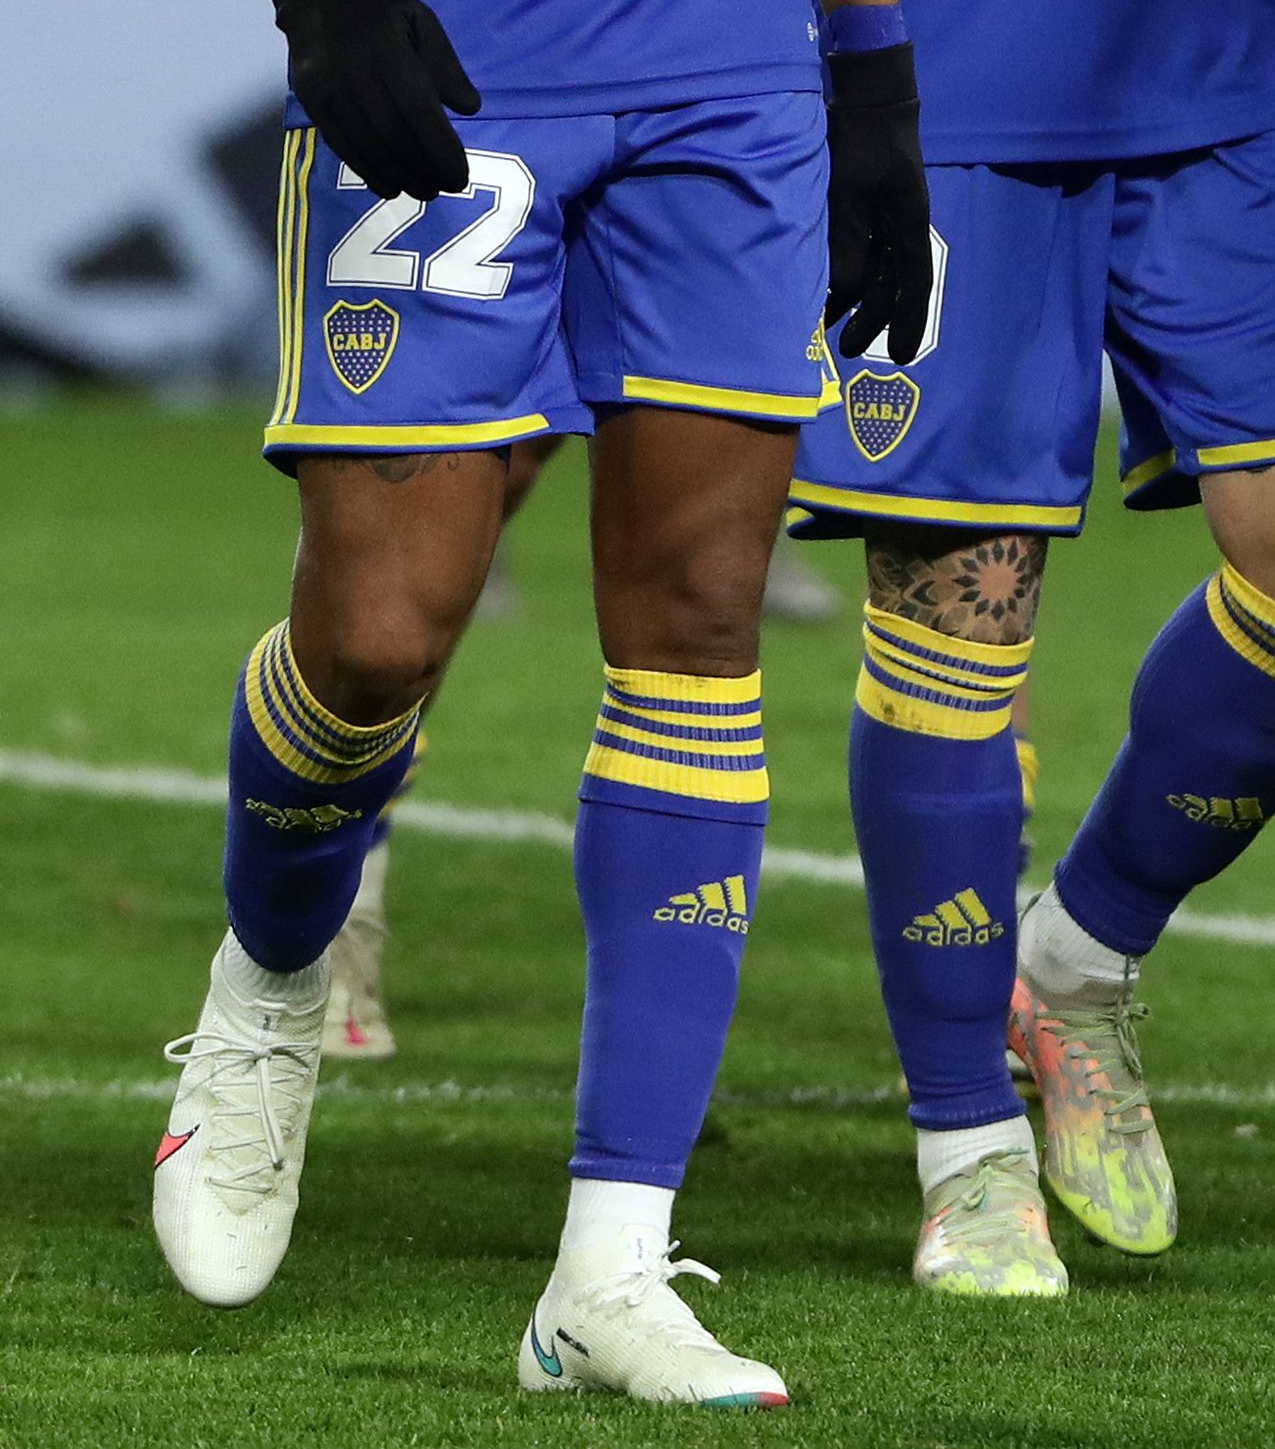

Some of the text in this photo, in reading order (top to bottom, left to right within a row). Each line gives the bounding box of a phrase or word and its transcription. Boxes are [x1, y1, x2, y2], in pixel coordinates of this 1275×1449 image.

[326, 147, 535, 300] 22
[334, 335, 386, 351] CABJ
[854, 403, 905, 420] CABJ
[653, 902, 749, 935] adidas
[903, 918, 1005, 947] adidas
